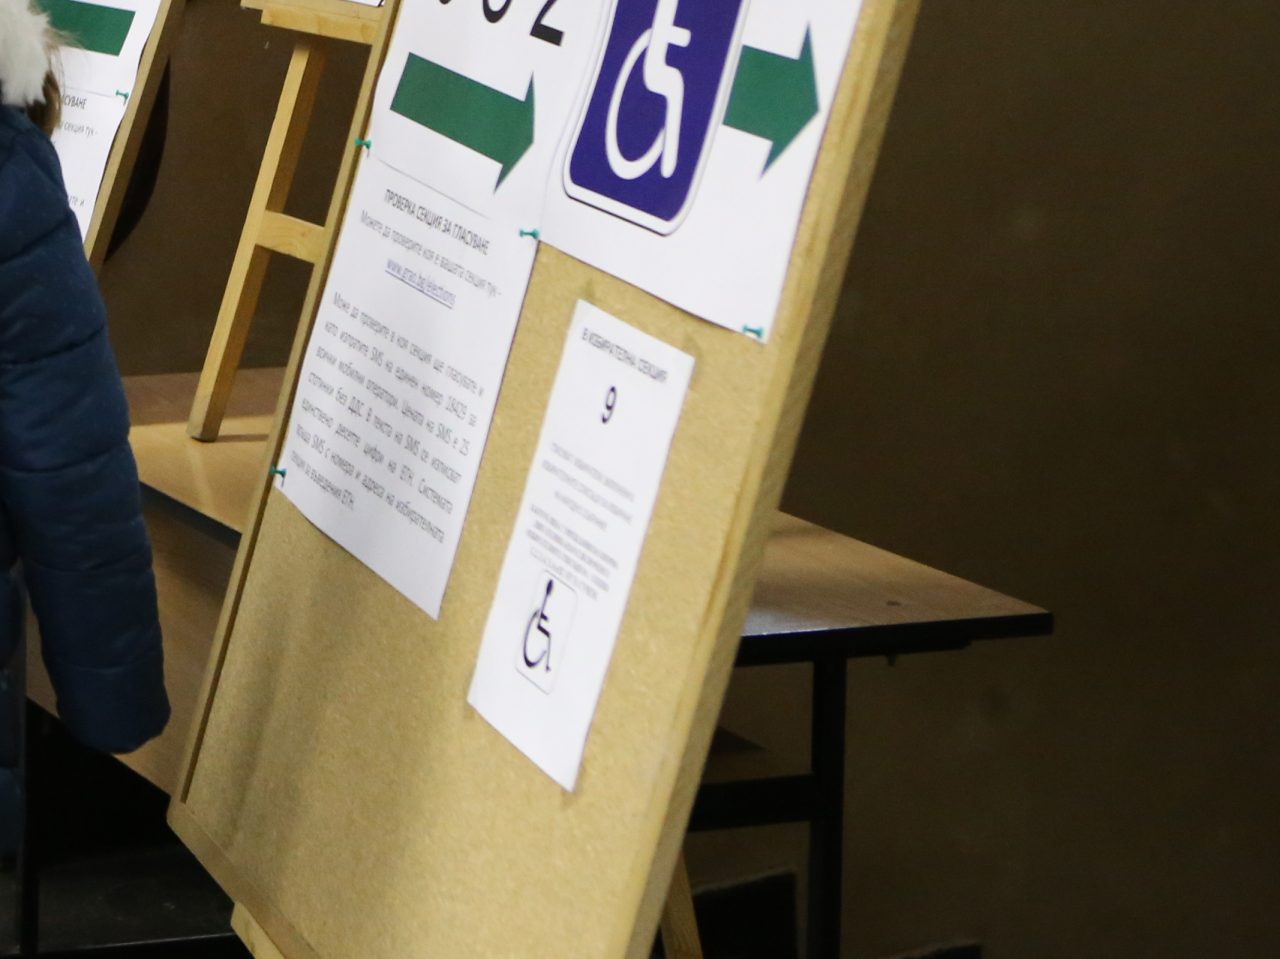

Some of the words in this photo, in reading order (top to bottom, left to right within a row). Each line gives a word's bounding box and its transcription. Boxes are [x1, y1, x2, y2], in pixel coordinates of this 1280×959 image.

[369, 346, 384, 366] SMS
[601, 386, 616, 424] 9
[310, 434, 325, 454] SMS
[435, 422, 452, 444] SMS
[404, 434, 420, 456] SMS
